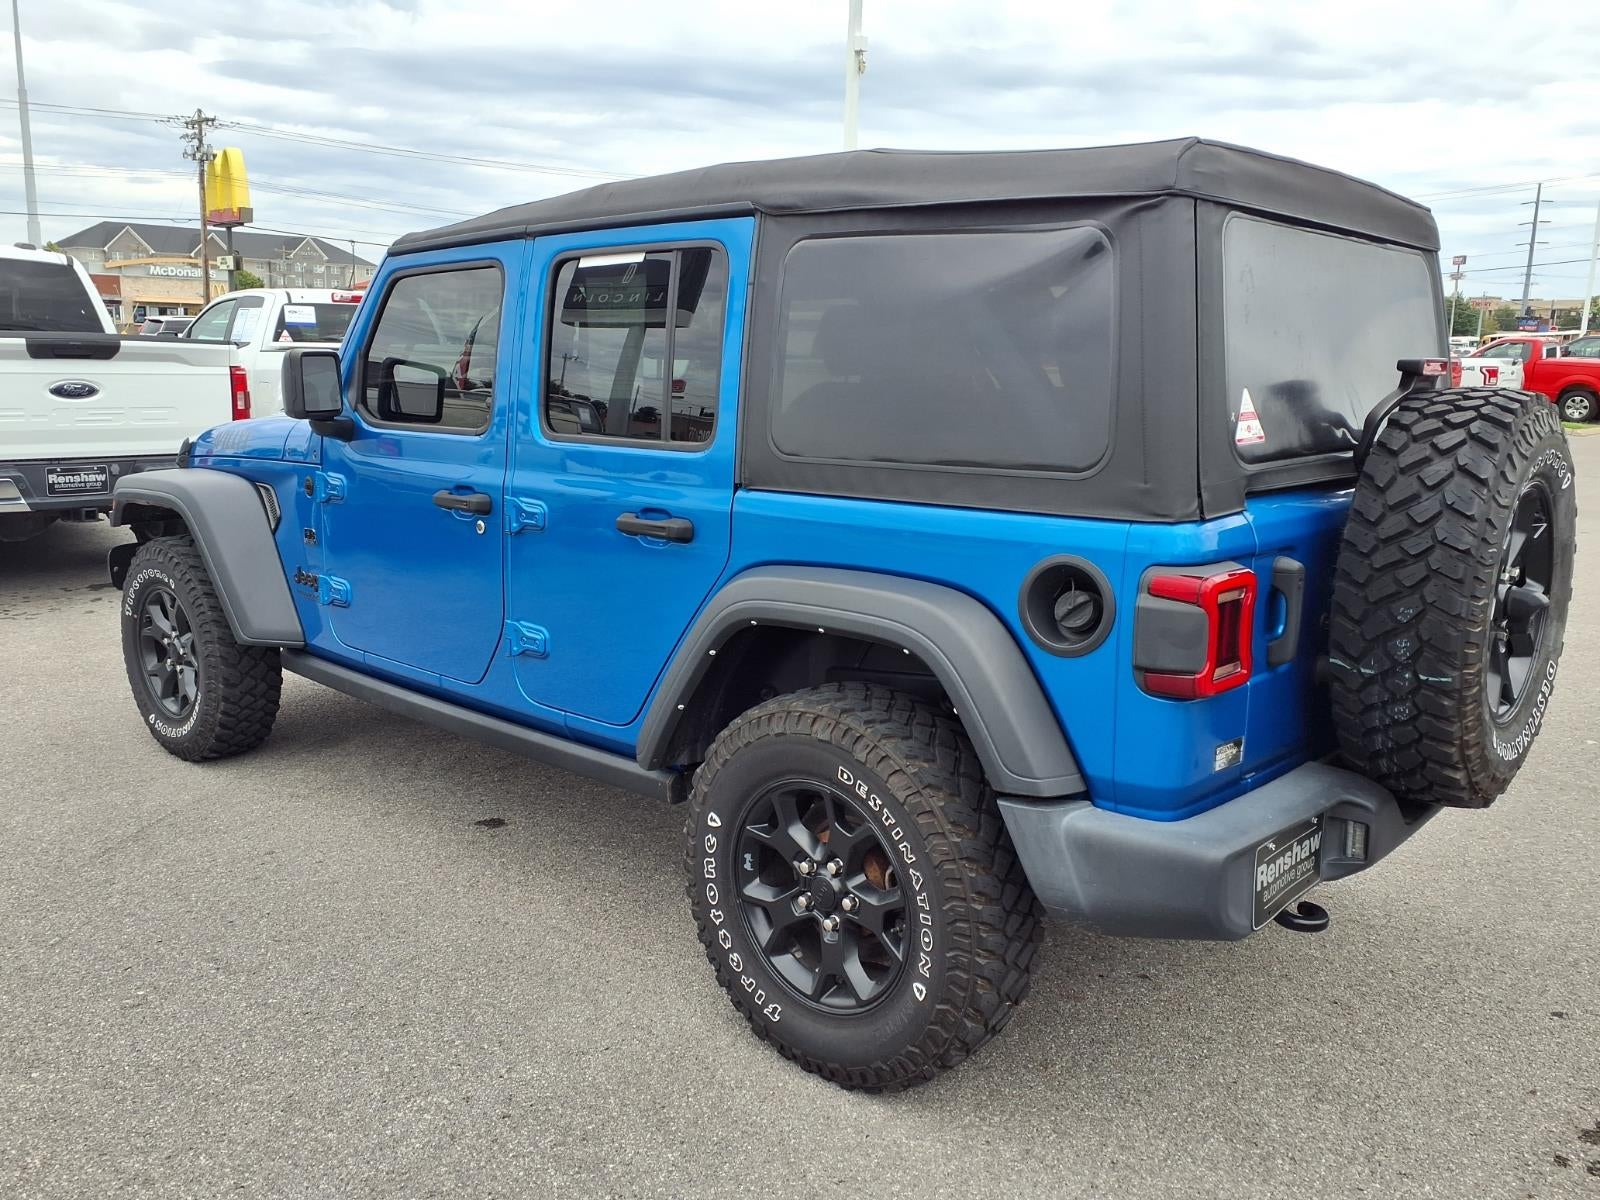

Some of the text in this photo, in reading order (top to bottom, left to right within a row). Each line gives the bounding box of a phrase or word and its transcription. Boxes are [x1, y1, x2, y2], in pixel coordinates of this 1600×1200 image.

[150, 265, 217, 278] McDonals
[62, 383, 90, 396] Ford
[48, 473, 106, 485] Renshaw
[86, 481, 102, 489] group
[837, 766, 933, 978] DESTINATION
[1256, 831, 1323, 892] Renshaw
[1263, 856, 1316, 903] automotive group
[703, 833, 782, 1022] Firestone
